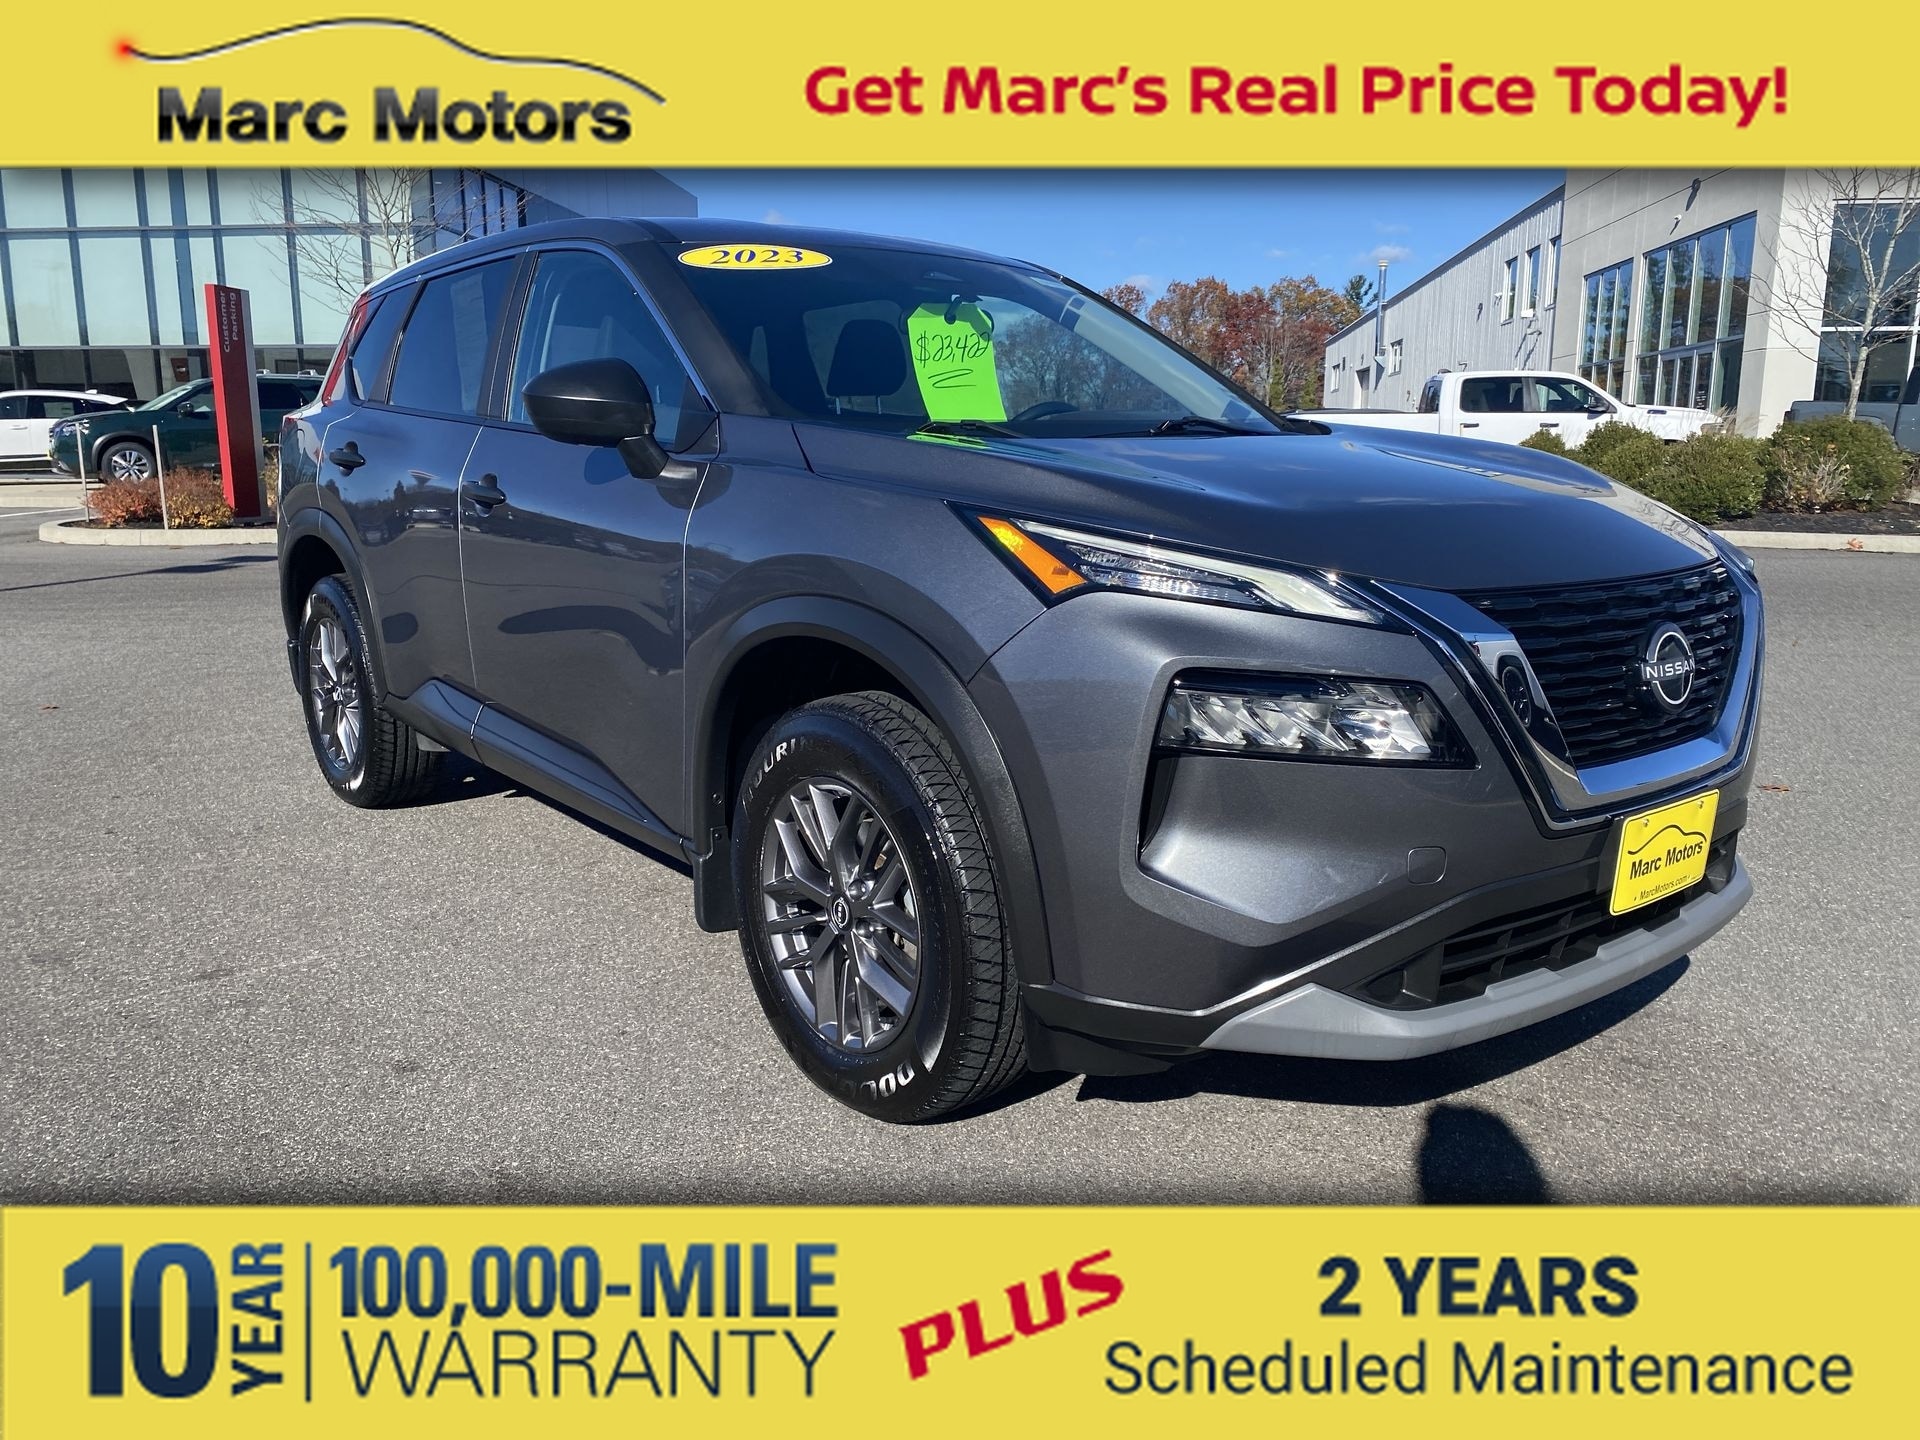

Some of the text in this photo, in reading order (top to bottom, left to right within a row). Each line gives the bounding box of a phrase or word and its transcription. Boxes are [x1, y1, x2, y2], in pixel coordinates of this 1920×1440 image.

[709, 249, 804, 264] 2023
[219, 290, 230, 353] Customer
[229, 292, 239, 341] Parking
[1645, 658, 1696, 679] NISSAN
[1629, 841, 1704, 880] Marc Motors
